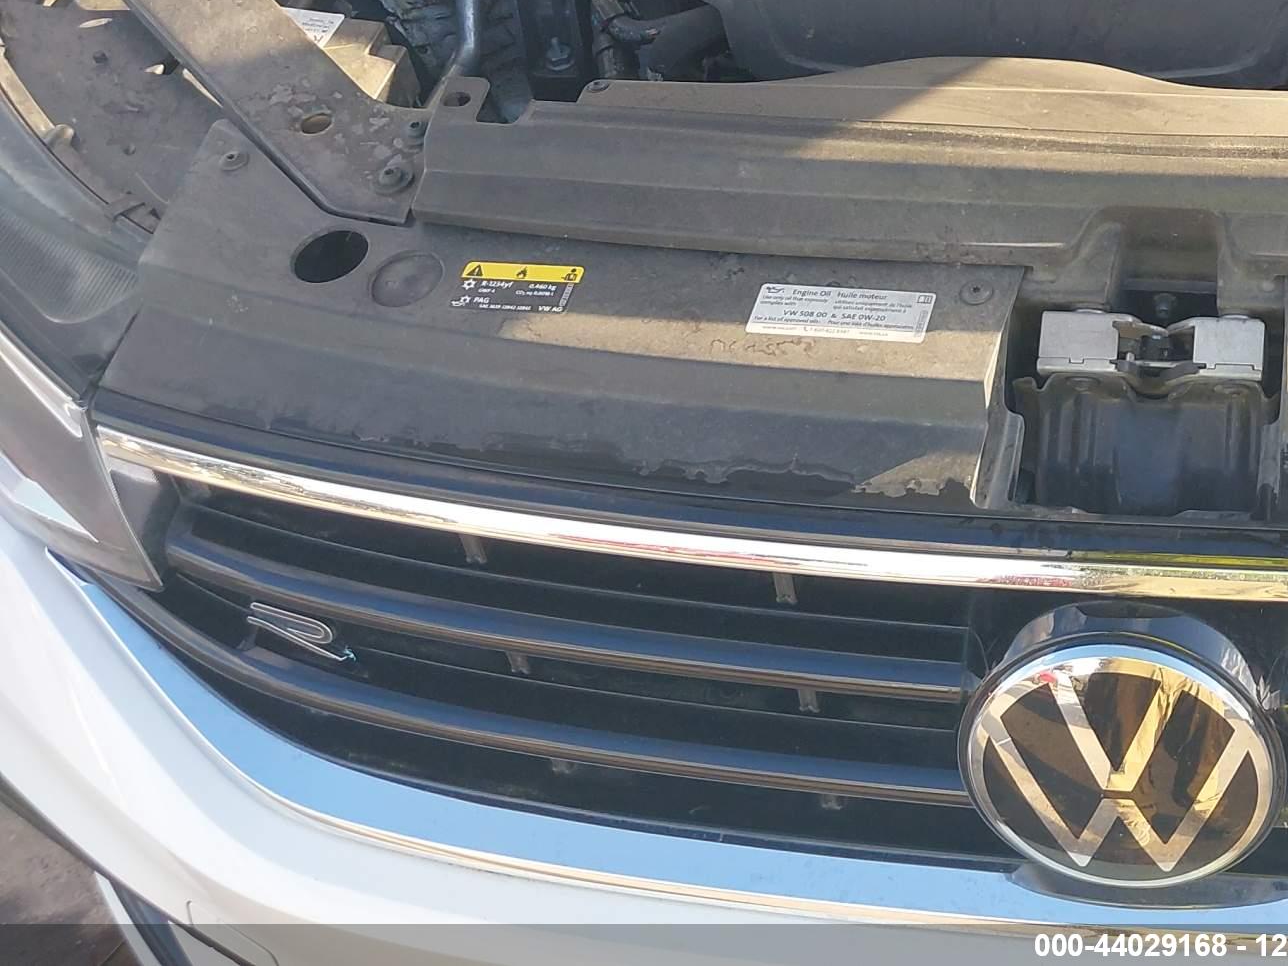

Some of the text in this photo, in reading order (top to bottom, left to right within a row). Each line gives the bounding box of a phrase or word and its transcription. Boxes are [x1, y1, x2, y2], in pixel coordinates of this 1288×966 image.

[481, 280, 514, 290] R-1234yf
[792, 289, 818, 297] Engine
[837, 291, 858, 299] Huile
[473, 296, 490, 304] PAG
[800, 310, 814, 318] 508
[858, 314, 886, 322] 0W-20
[246, 600, 356, 662] R
